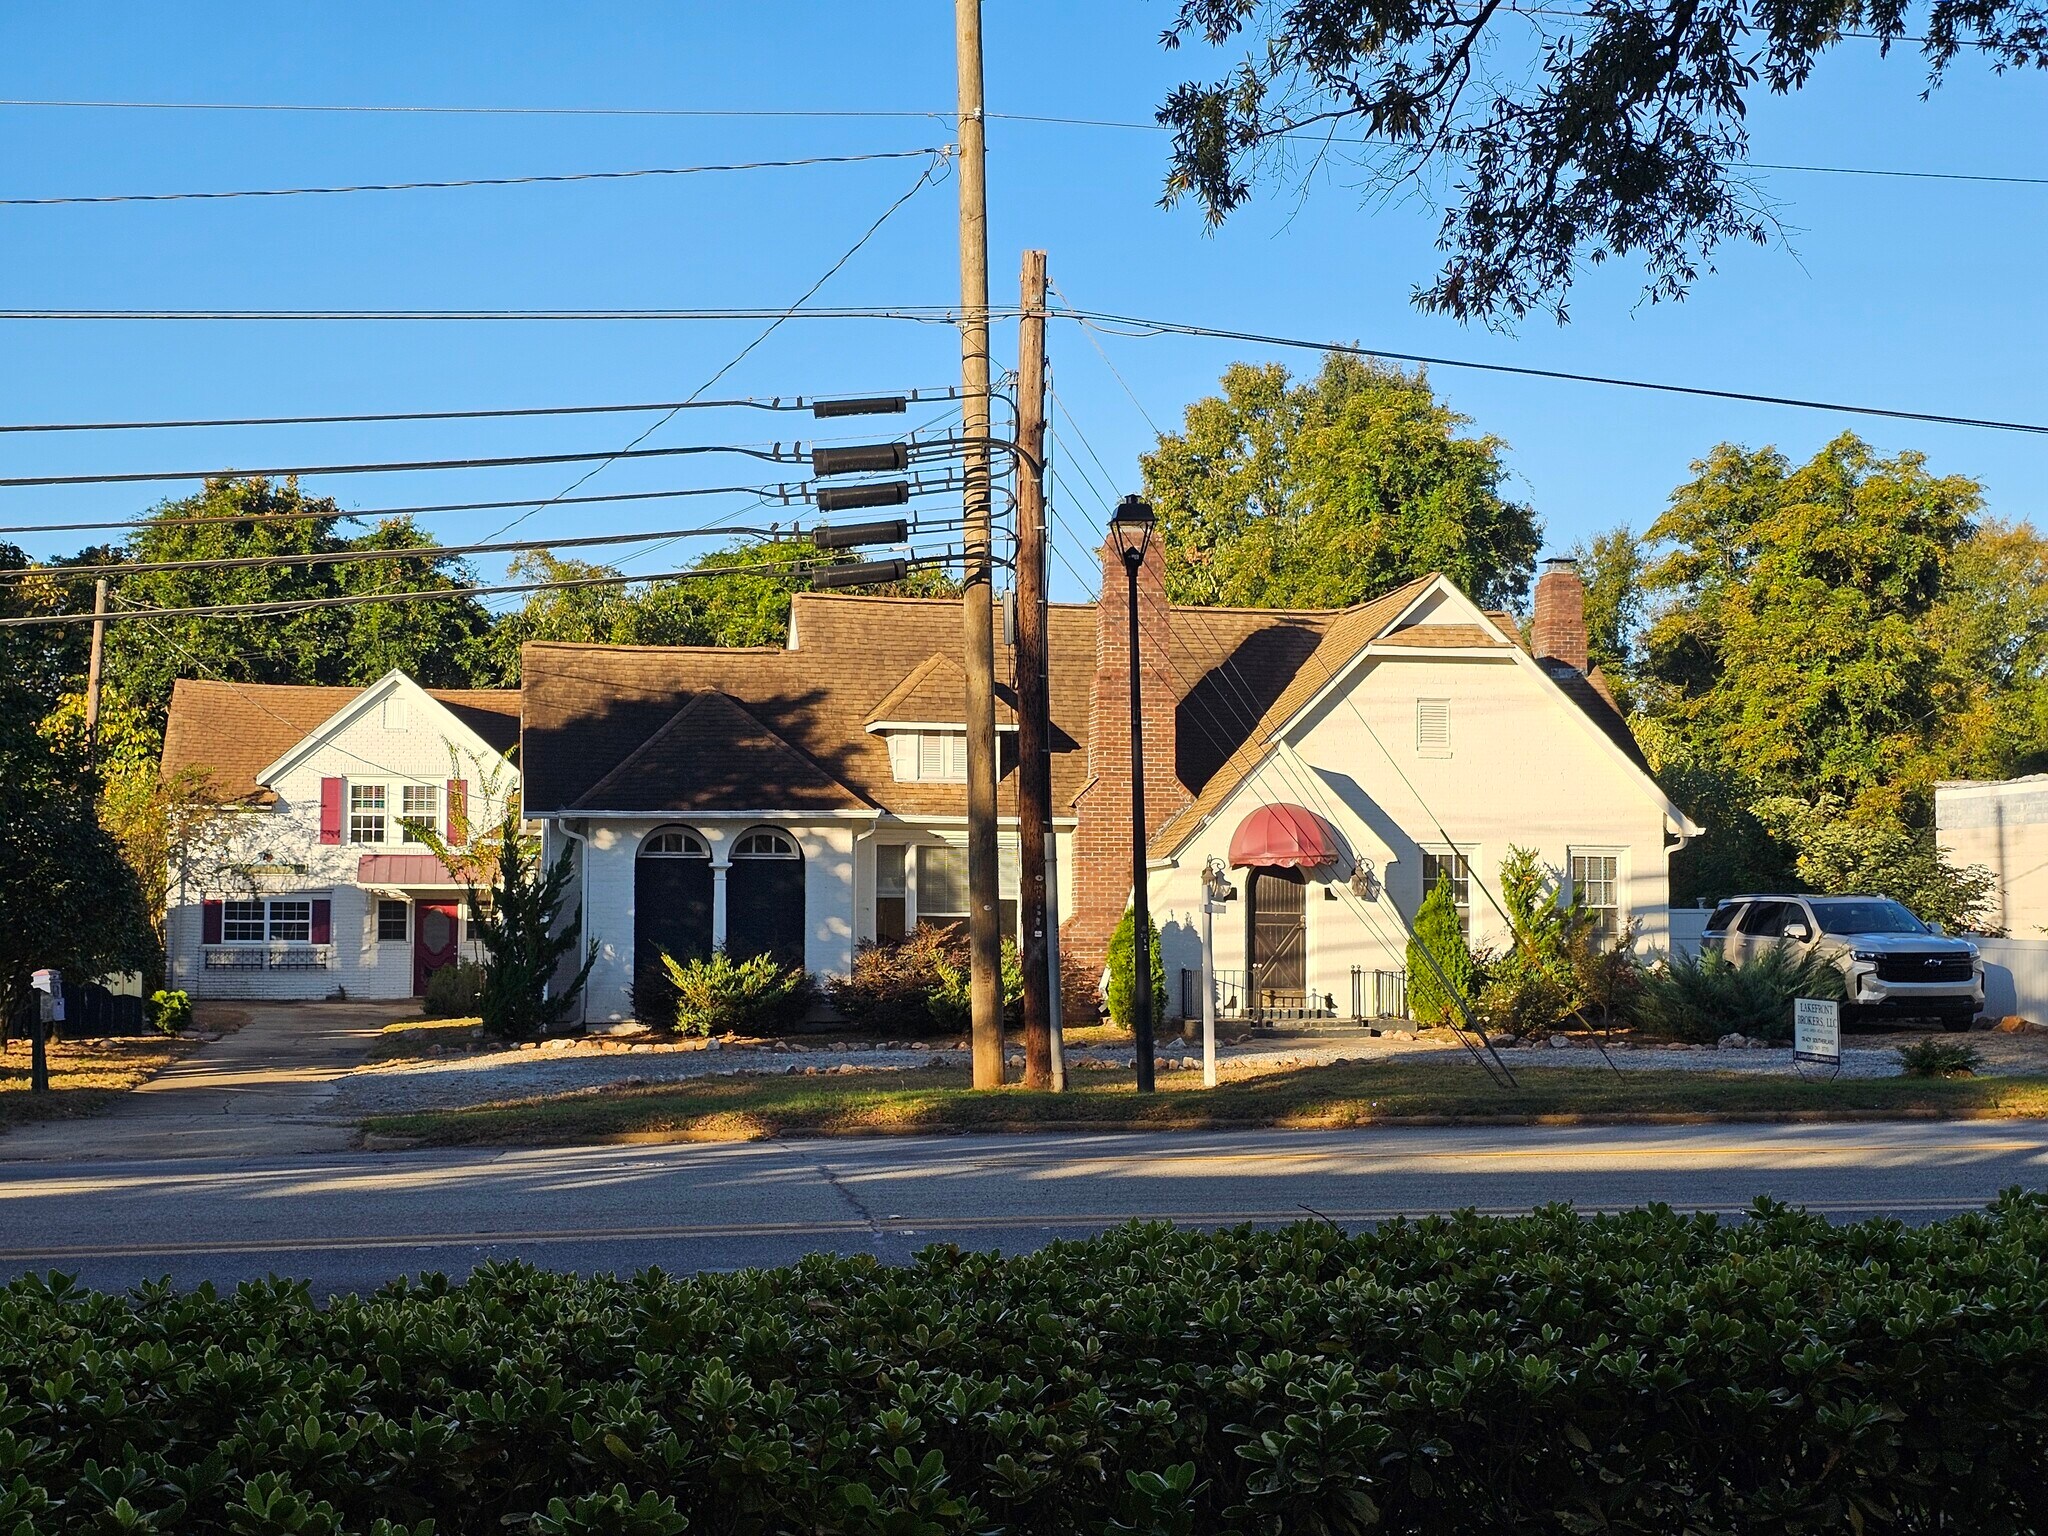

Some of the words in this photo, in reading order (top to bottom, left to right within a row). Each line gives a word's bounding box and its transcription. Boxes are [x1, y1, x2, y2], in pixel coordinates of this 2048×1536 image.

[1800, 1003, 1833, 1015] LAKEFRONT
[1797, 1015, 1825, 1027] BROKERS,
[1826, 1017, 1838, 1028] LLC
